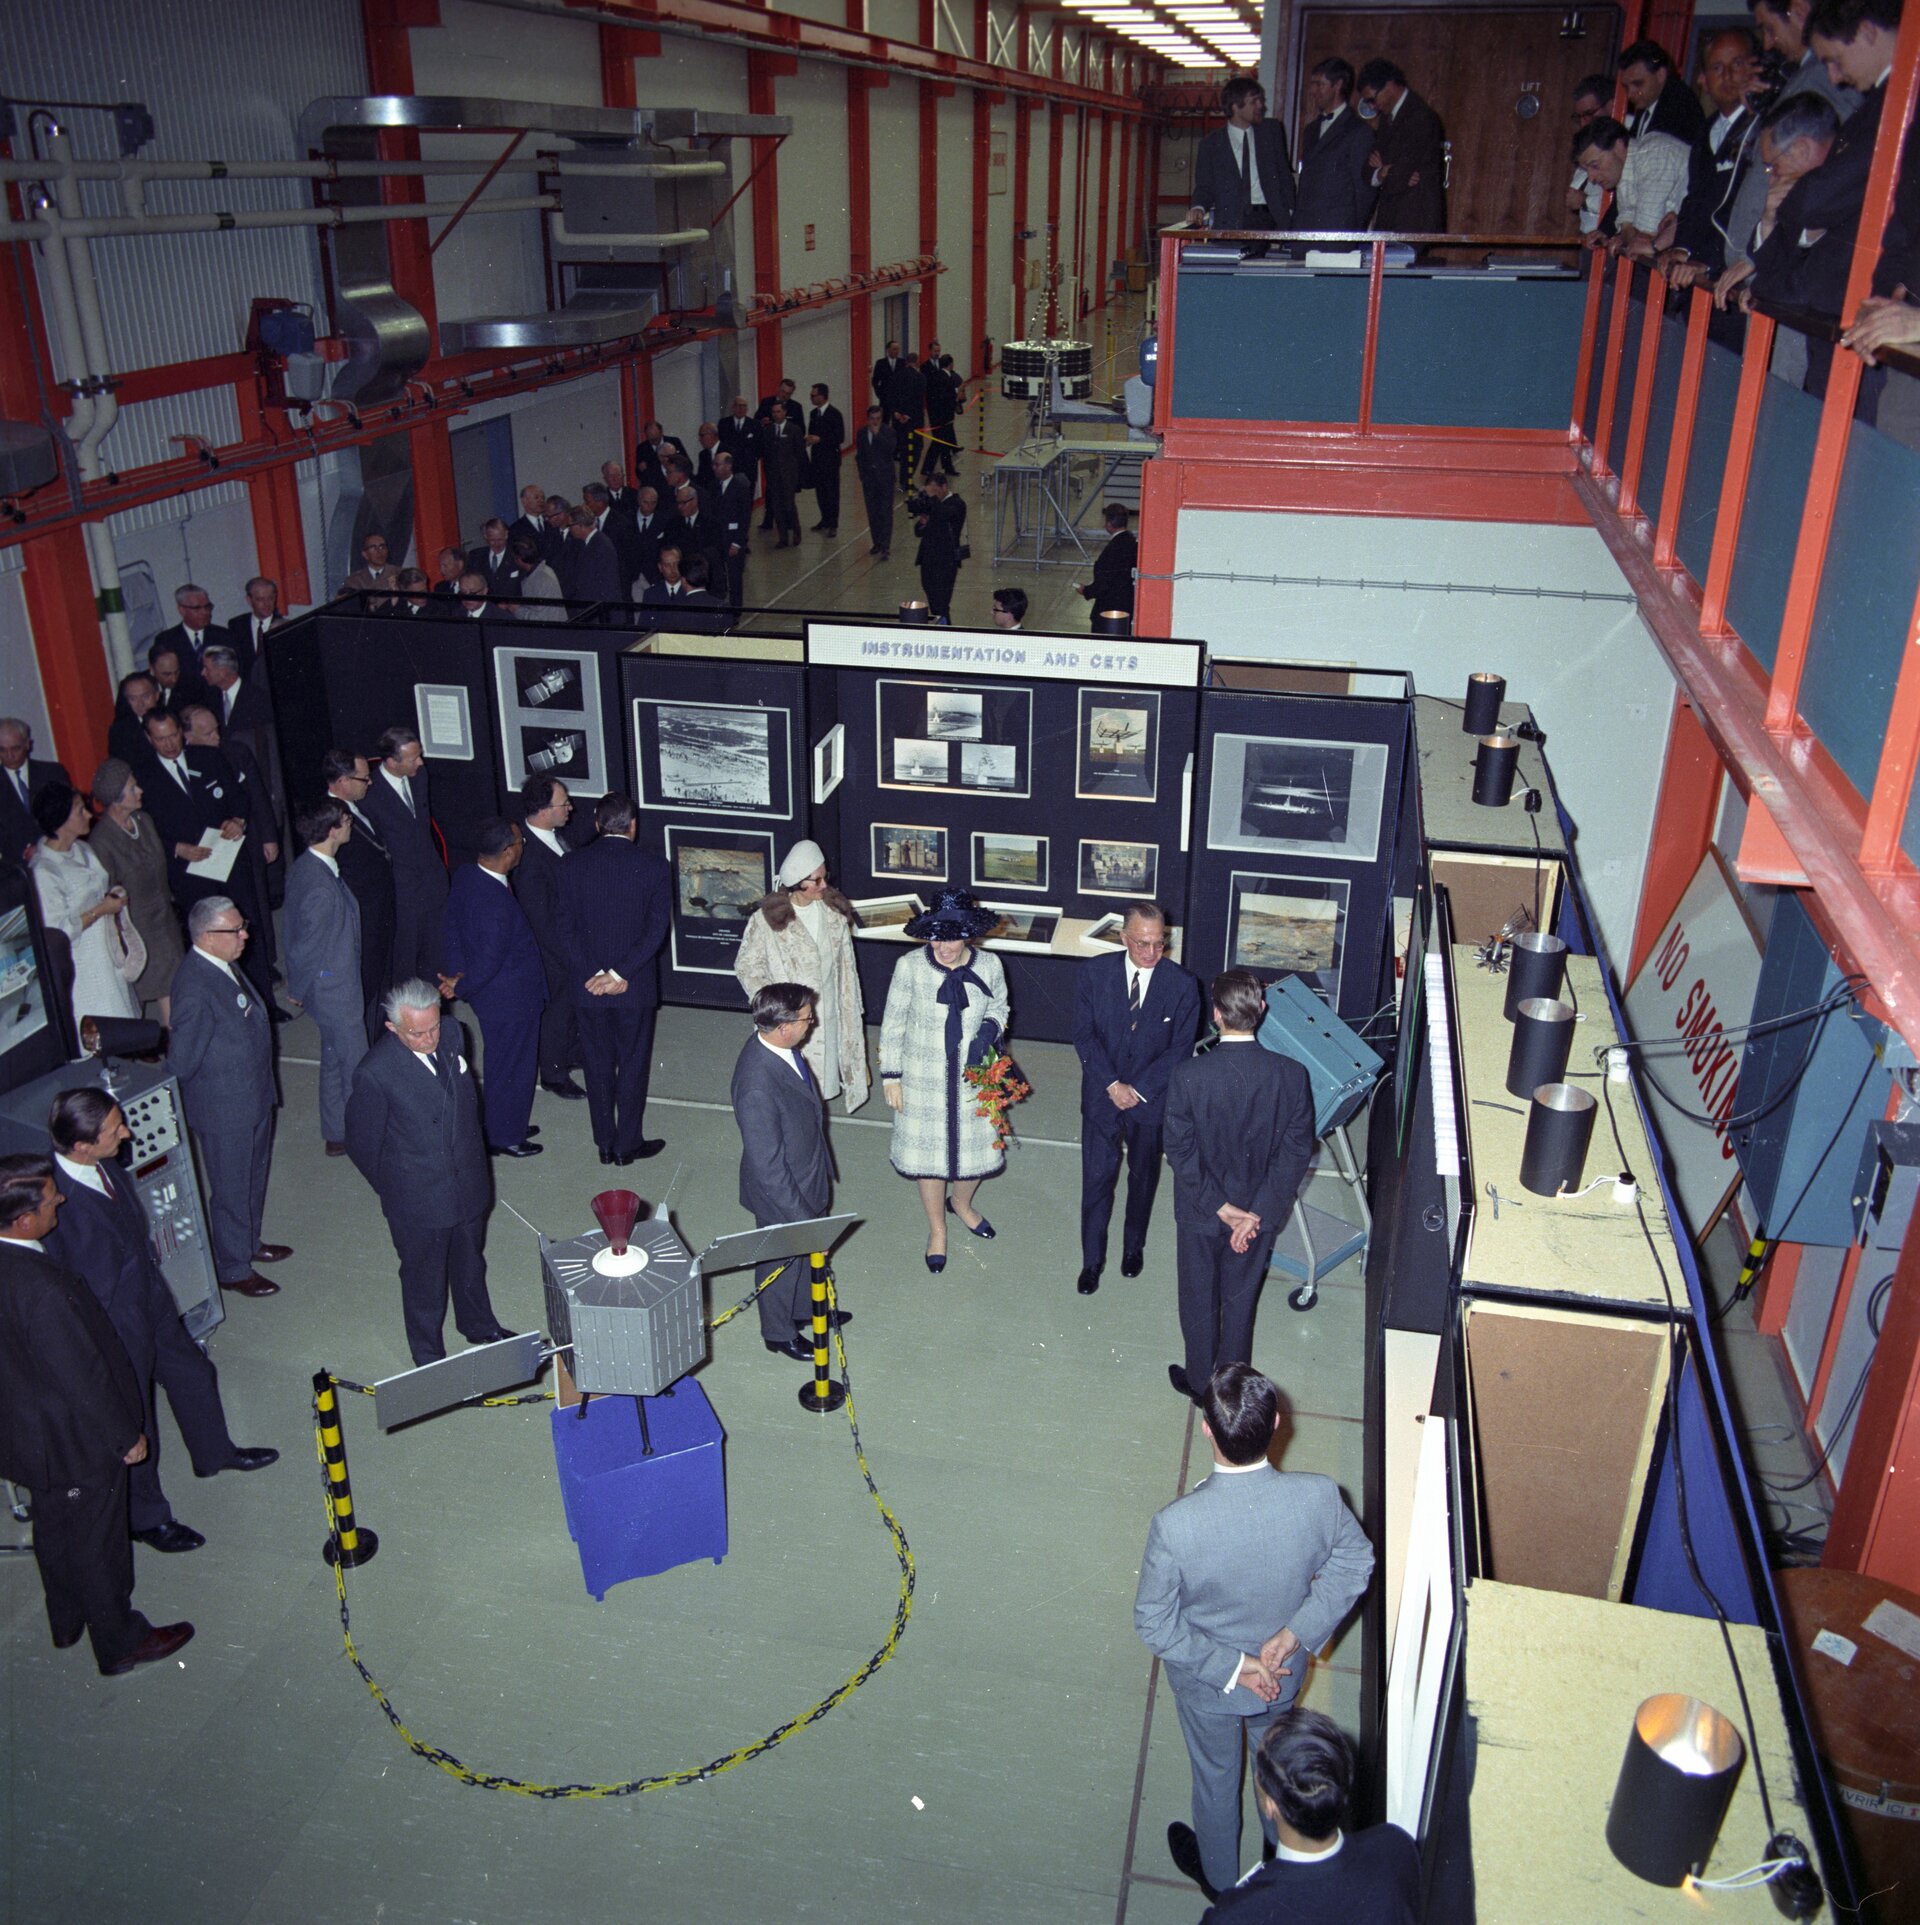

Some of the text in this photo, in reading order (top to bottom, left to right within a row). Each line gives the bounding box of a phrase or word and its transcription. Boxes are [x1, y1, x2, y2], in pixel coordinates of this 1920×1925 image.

[1521, 82, 1542, 92] LIFT
[861, 640, 1139, 670] INSTRUMENTATION AND CETS
[1654, 921, 1690, 992] NO
[1886, 1803, 1905, 1815] ICI
